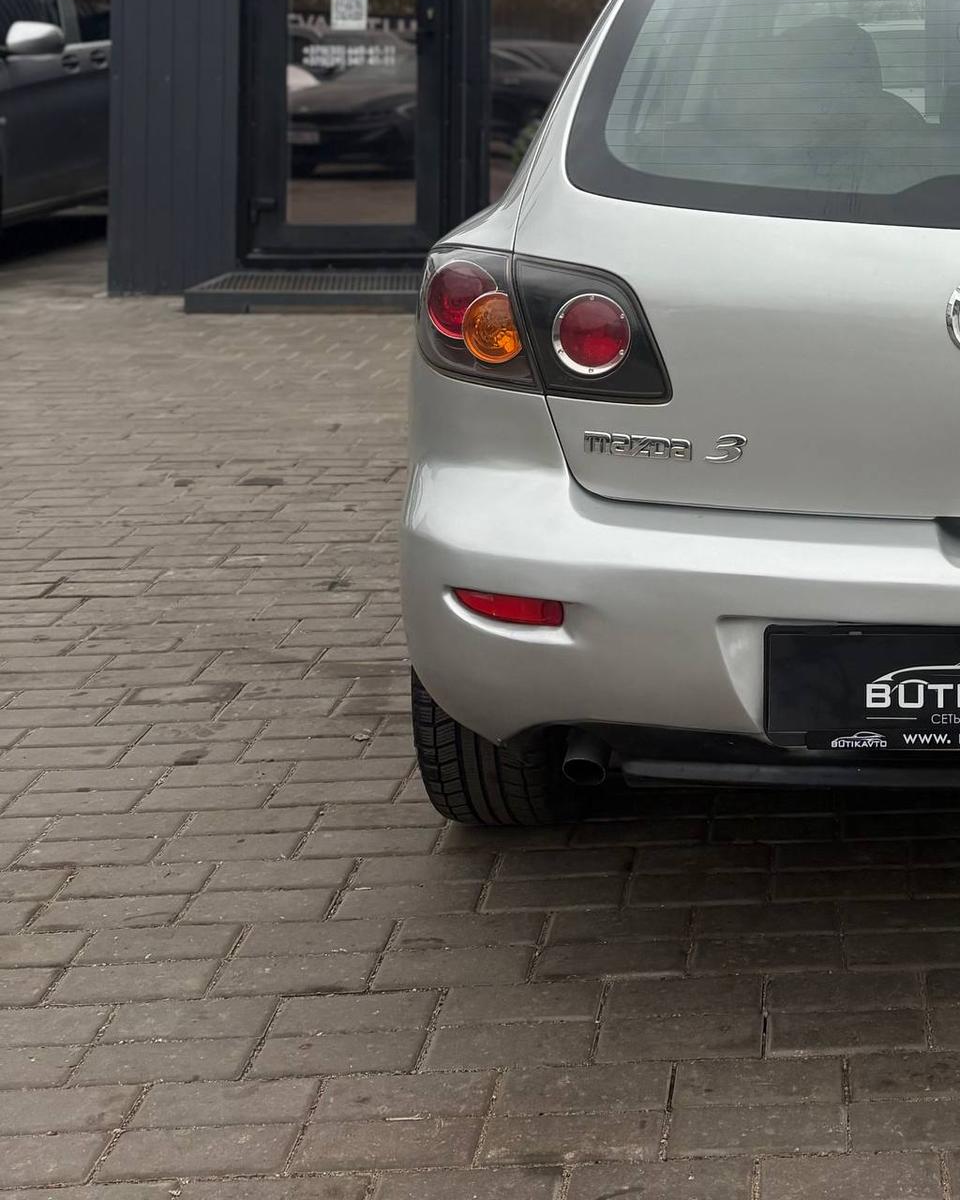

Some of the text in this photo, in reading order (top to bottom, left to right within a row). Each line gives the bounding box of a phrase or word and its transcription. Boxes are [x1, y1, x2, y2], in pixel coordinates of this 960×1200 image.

[704, 433, 748, 464] 3
[931, 713, 960, 724] СЕТЬ
[831, 740, 887, 748] BUTIKAVTO
[903, 733, 951, 744] WWW.
